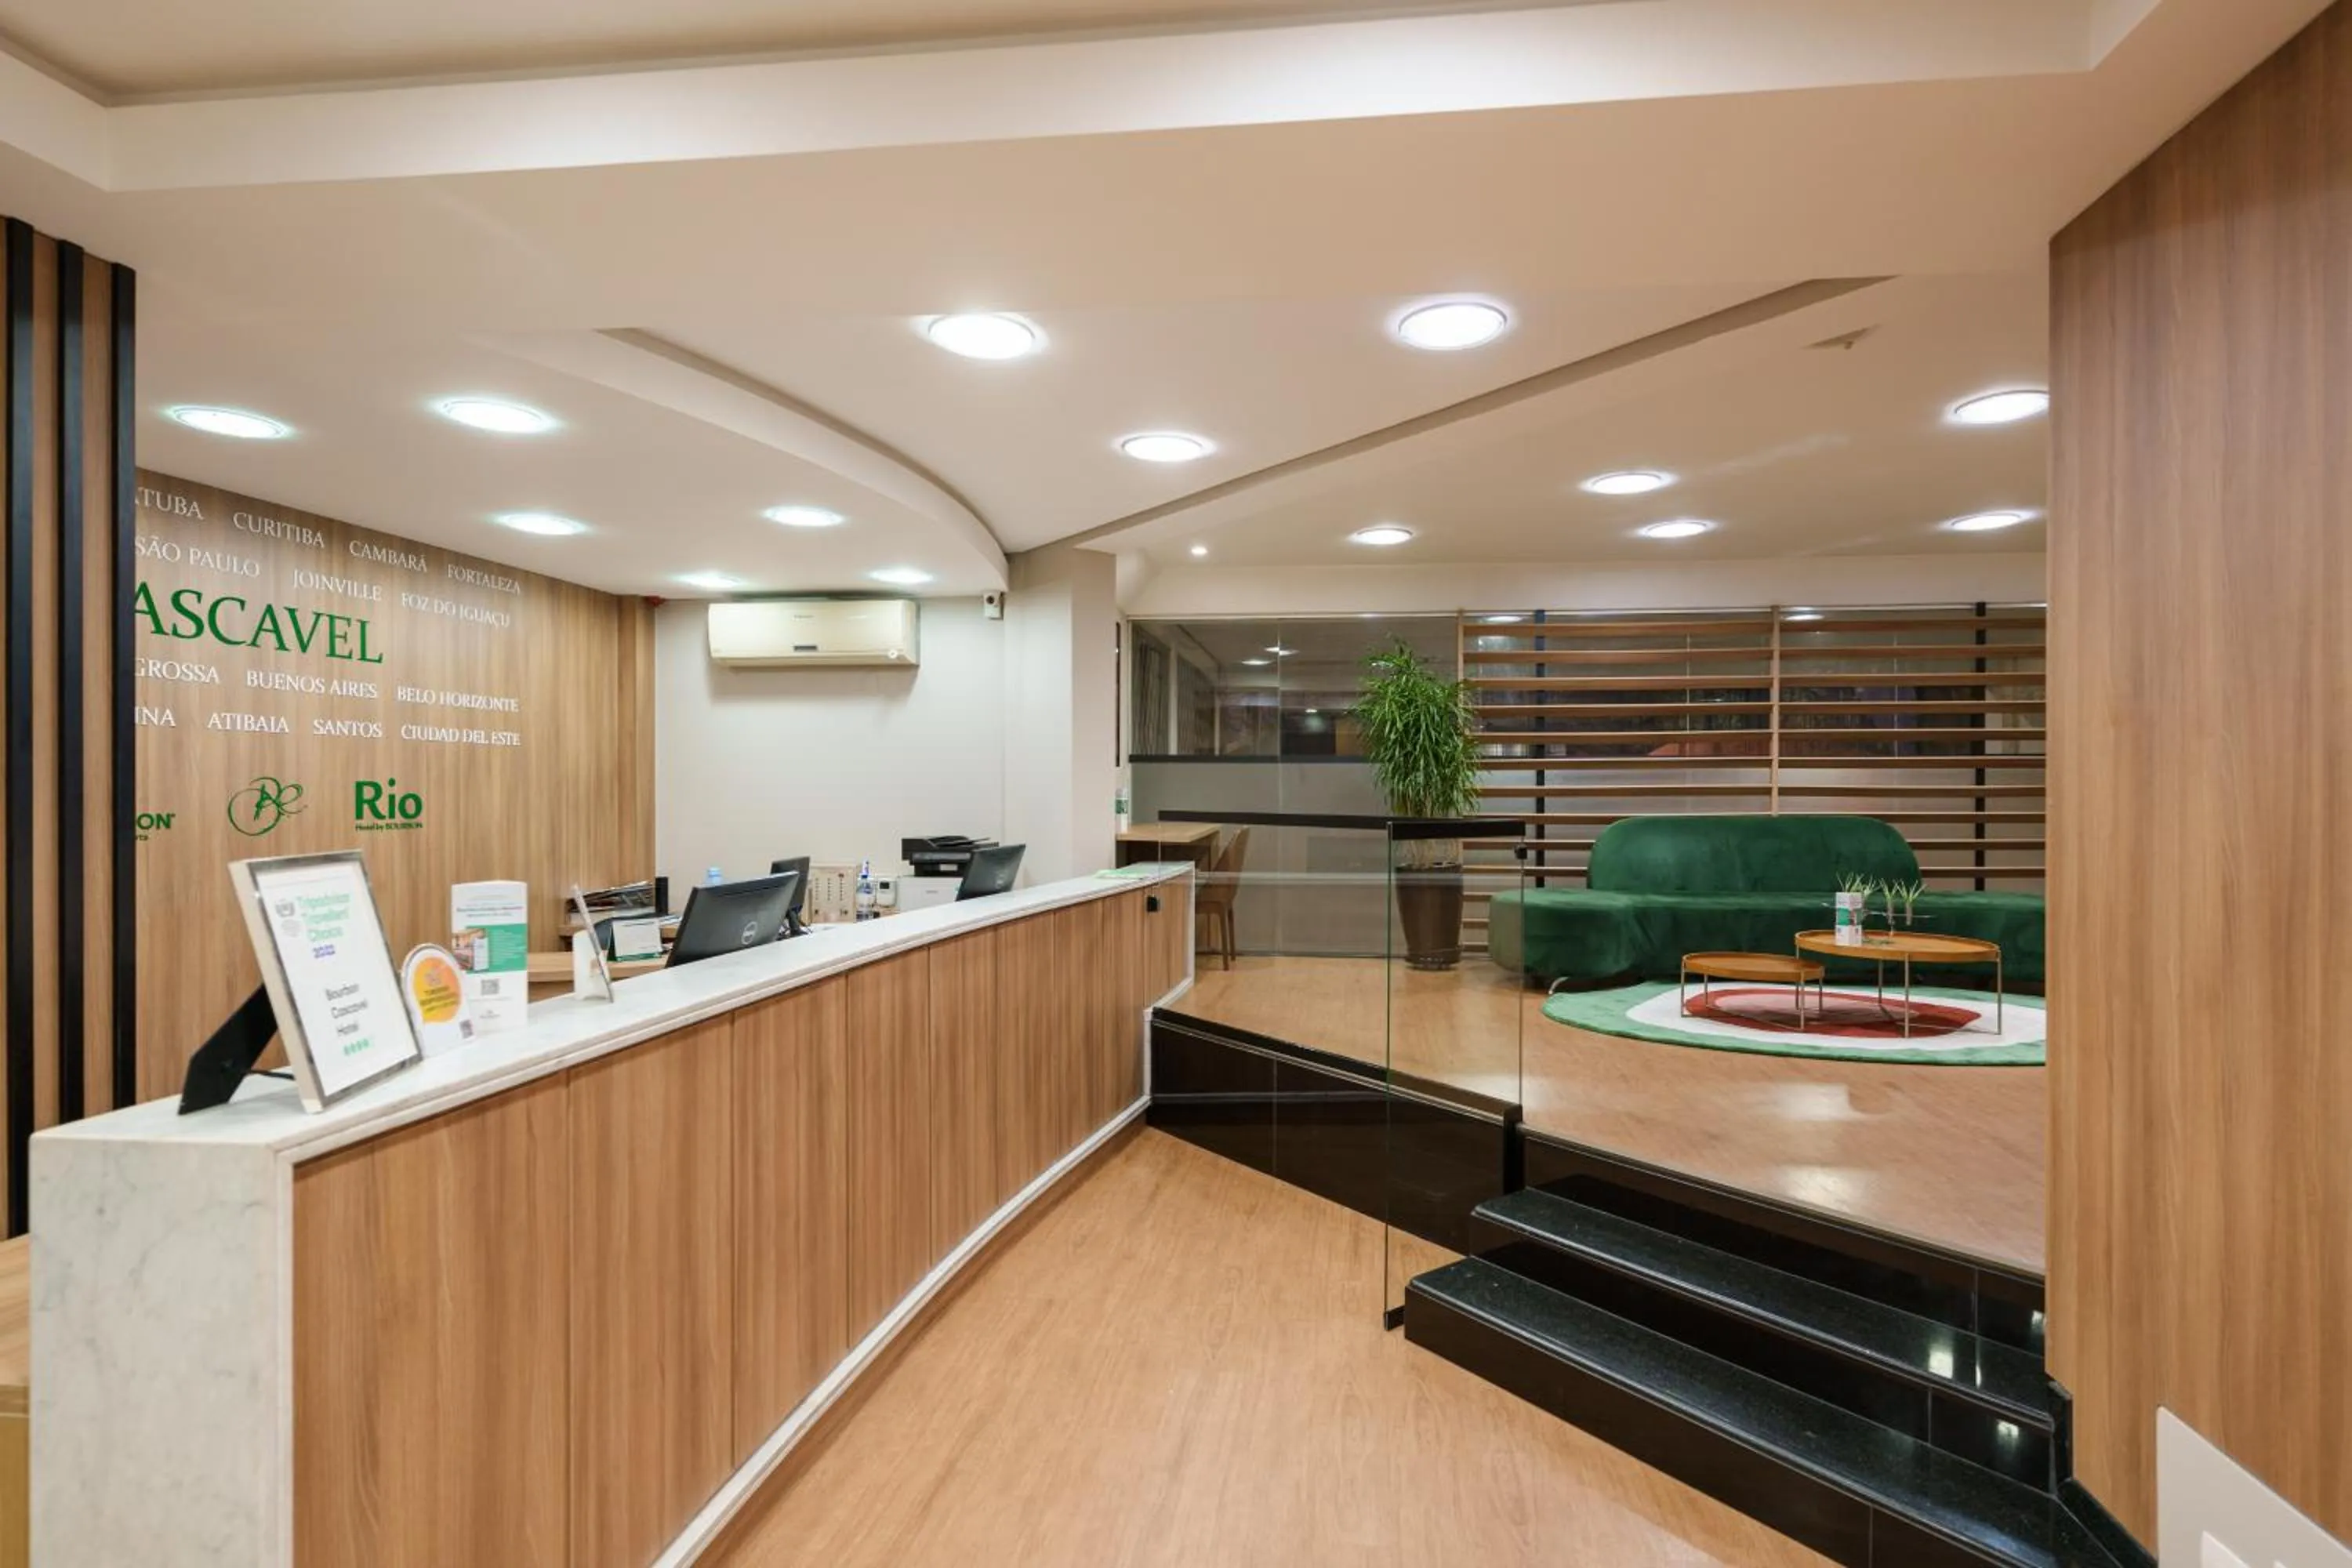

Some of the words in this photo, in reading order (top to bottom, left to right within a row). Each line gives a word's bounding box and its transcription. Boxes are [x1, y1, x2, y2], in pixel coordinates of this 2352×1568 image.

[135, 534, 181, 562] SÃO
[189, 548, 260, 578] PAULO
[292, 569, 383, 601] JOINVILLE
[401, 592, 430, 612] FOZ
[434, 598, 456, 616] DO
[459, 604, 510, 629] IGUAÇU
[233, 512, 325, 548] CURITIBA
[349, 540, 427, 572] CAMBARÁ
[447, 564, 521, 597] FORTALEZA
[135, 580, 383, 664] ASCAVEL
[135, 658, 220, 684] GROSSA
[246, 670, 325, 694] BUENOS
[330, 679, 378, 699] AIRES
[397, 685, 435, 705] BELO
[440, 691, 519, 713] HORIZONTE
[207, 712, 289, 733] ATIBAIA
[314, 719, 383, 738] SANTOS
[401, 724, 459, 742] CIUDAD
[463, 728, 489, 744] DEL
[492, 731, 521, 746] ESTE
[355, 777, 422, 819] Rio
